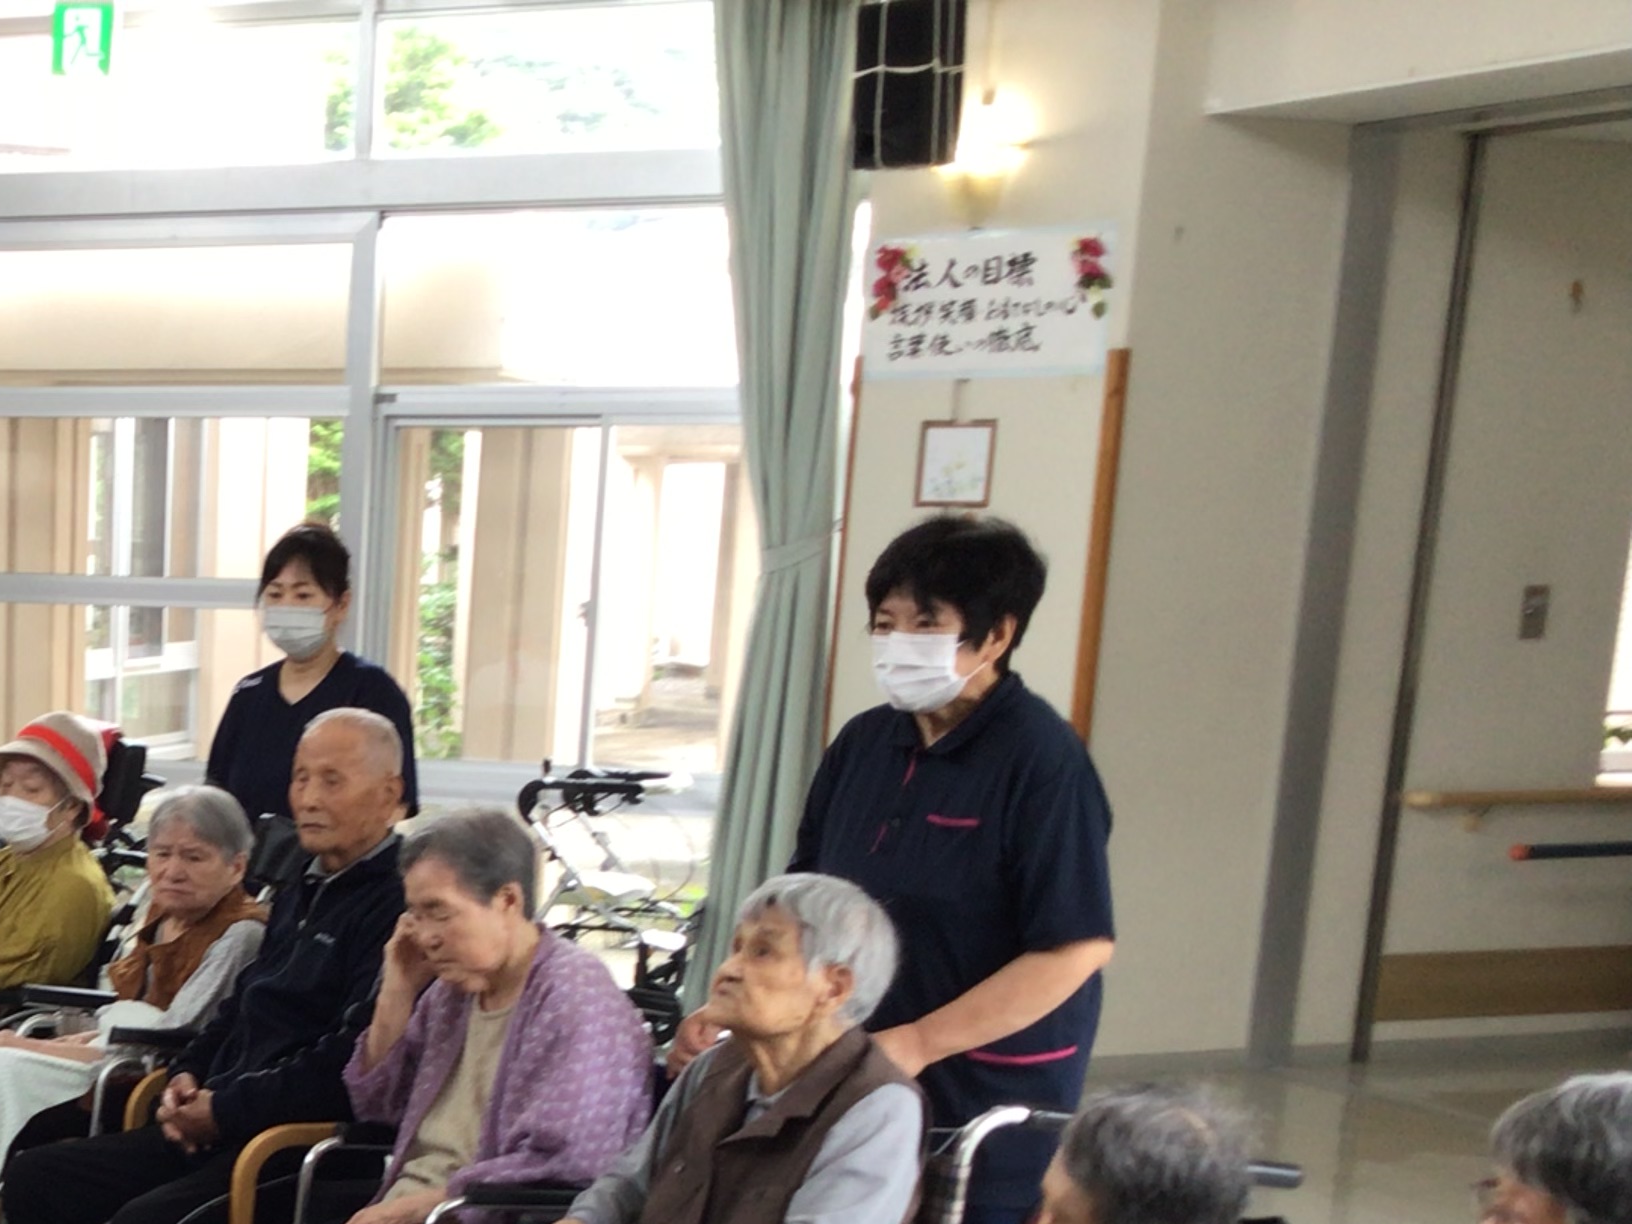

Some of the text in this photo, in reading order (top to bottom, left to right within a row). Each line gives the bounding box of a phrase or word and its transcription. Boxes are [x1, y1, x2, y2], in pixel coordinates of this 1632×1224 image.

[903, 252, 1037, 291] 法人の目標
